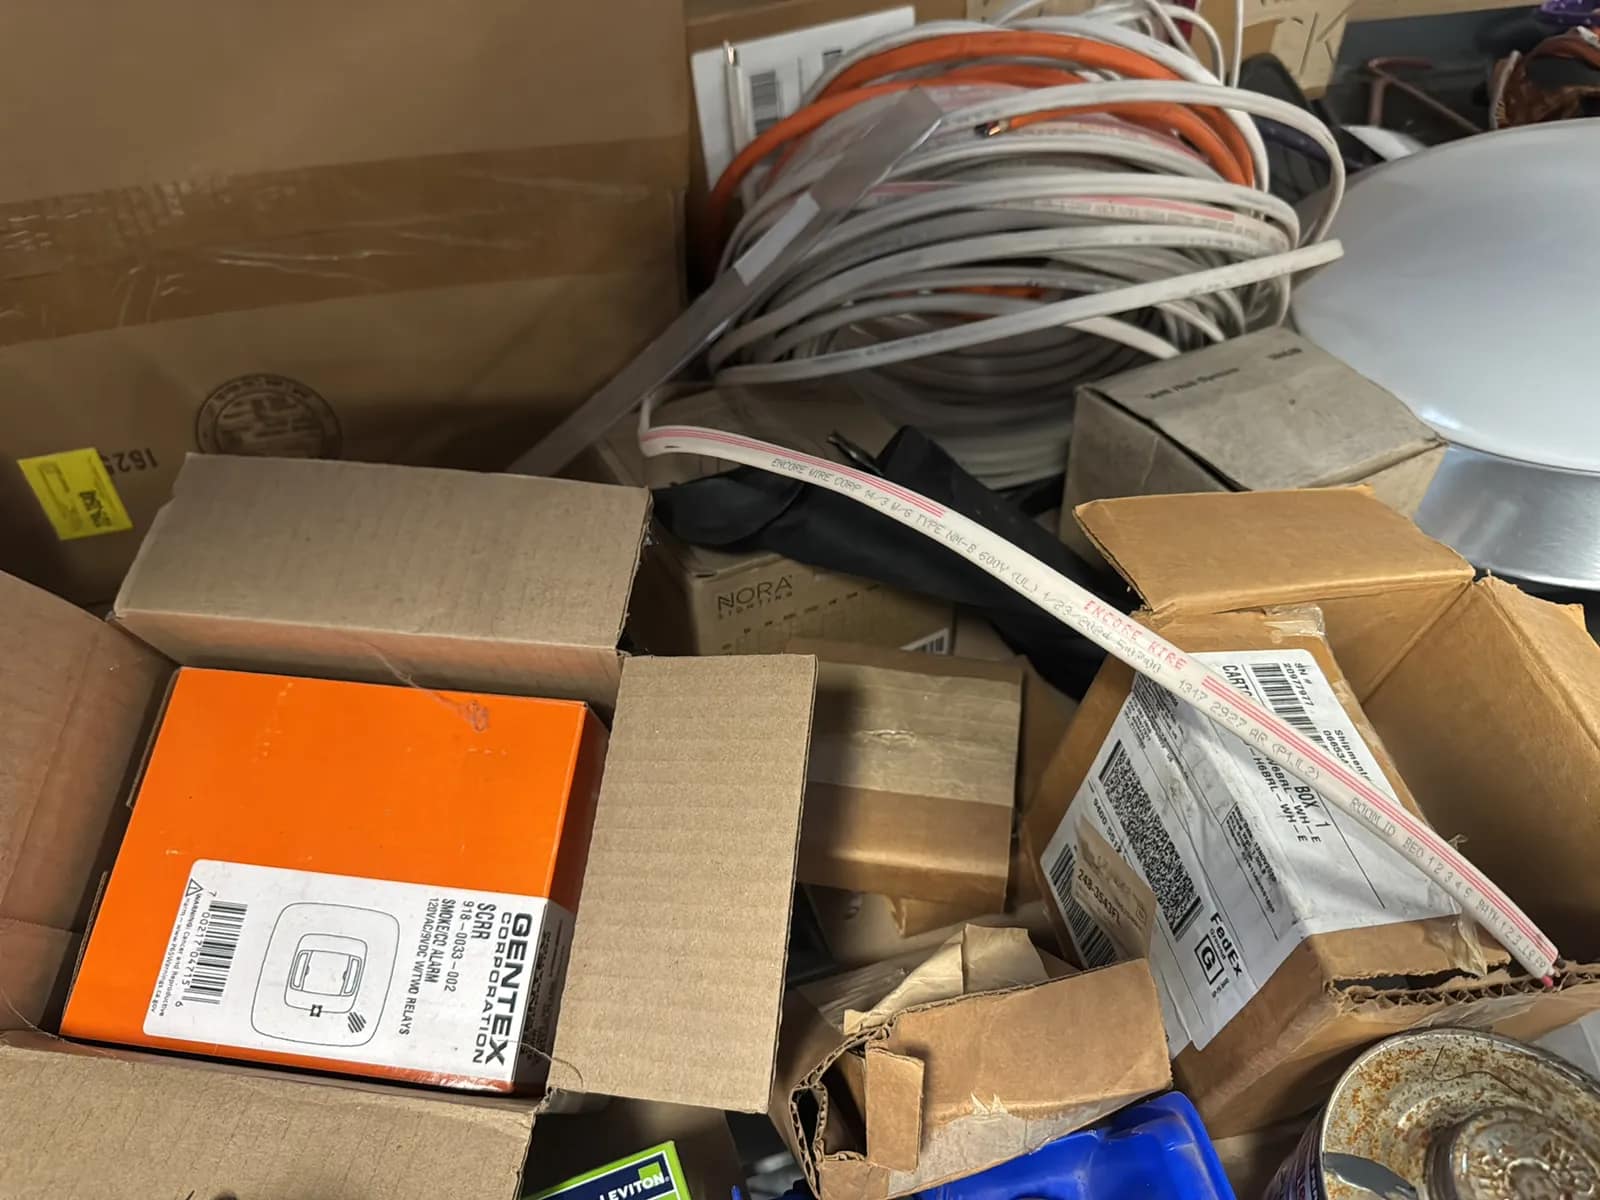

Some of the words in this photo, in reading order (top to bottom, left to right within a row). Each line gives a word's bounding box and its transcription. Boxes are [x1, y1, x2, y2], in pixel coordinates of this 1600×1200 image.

[718, 576, 792, 611] NORA
[1083, 599, 1143, 641] ENCORE
[1148, 639, 1188, 671] WIRE
[771, 458, 809, 474] ENCORE
[808, 466, 832, 483] WIRE
[834, 477, 862, 494] CORP
[916, 513, 946, 535] TYPE
[945, 530, 977, 554] NM-B
[978, 549, 1010, 574] 600V
[1011, 570, 1039, 593] (UL)
[1209, 701, 1247, 728] 2927
[1249, 728, 1268, 746] AR
[1402, 837, 1424, 857] BED
[1434, 862, 1444, 874] 2
[1294, 786, 1320, 808] BOX
[194, 911, 211, 946] 00217
[416, 897, 440, 958] 120VAC/9VDC
[471, 903, 496, 940] SCRR
[444, 900, 475, 992] 918-0033-002
[1201, 946, 1215, 971] G
[1210, 912, 1242, 977] FedEx
[182, 951, 199, 986] 04715
[407, 960, 425, 995] W/TWO
[424, 949, 444, 983] ALARM
[473, 912, 512, 1063] CORPORATION
[485, 912, 533, 1065] GENTEX
[398, 997, 417, 1035] RELAYS
